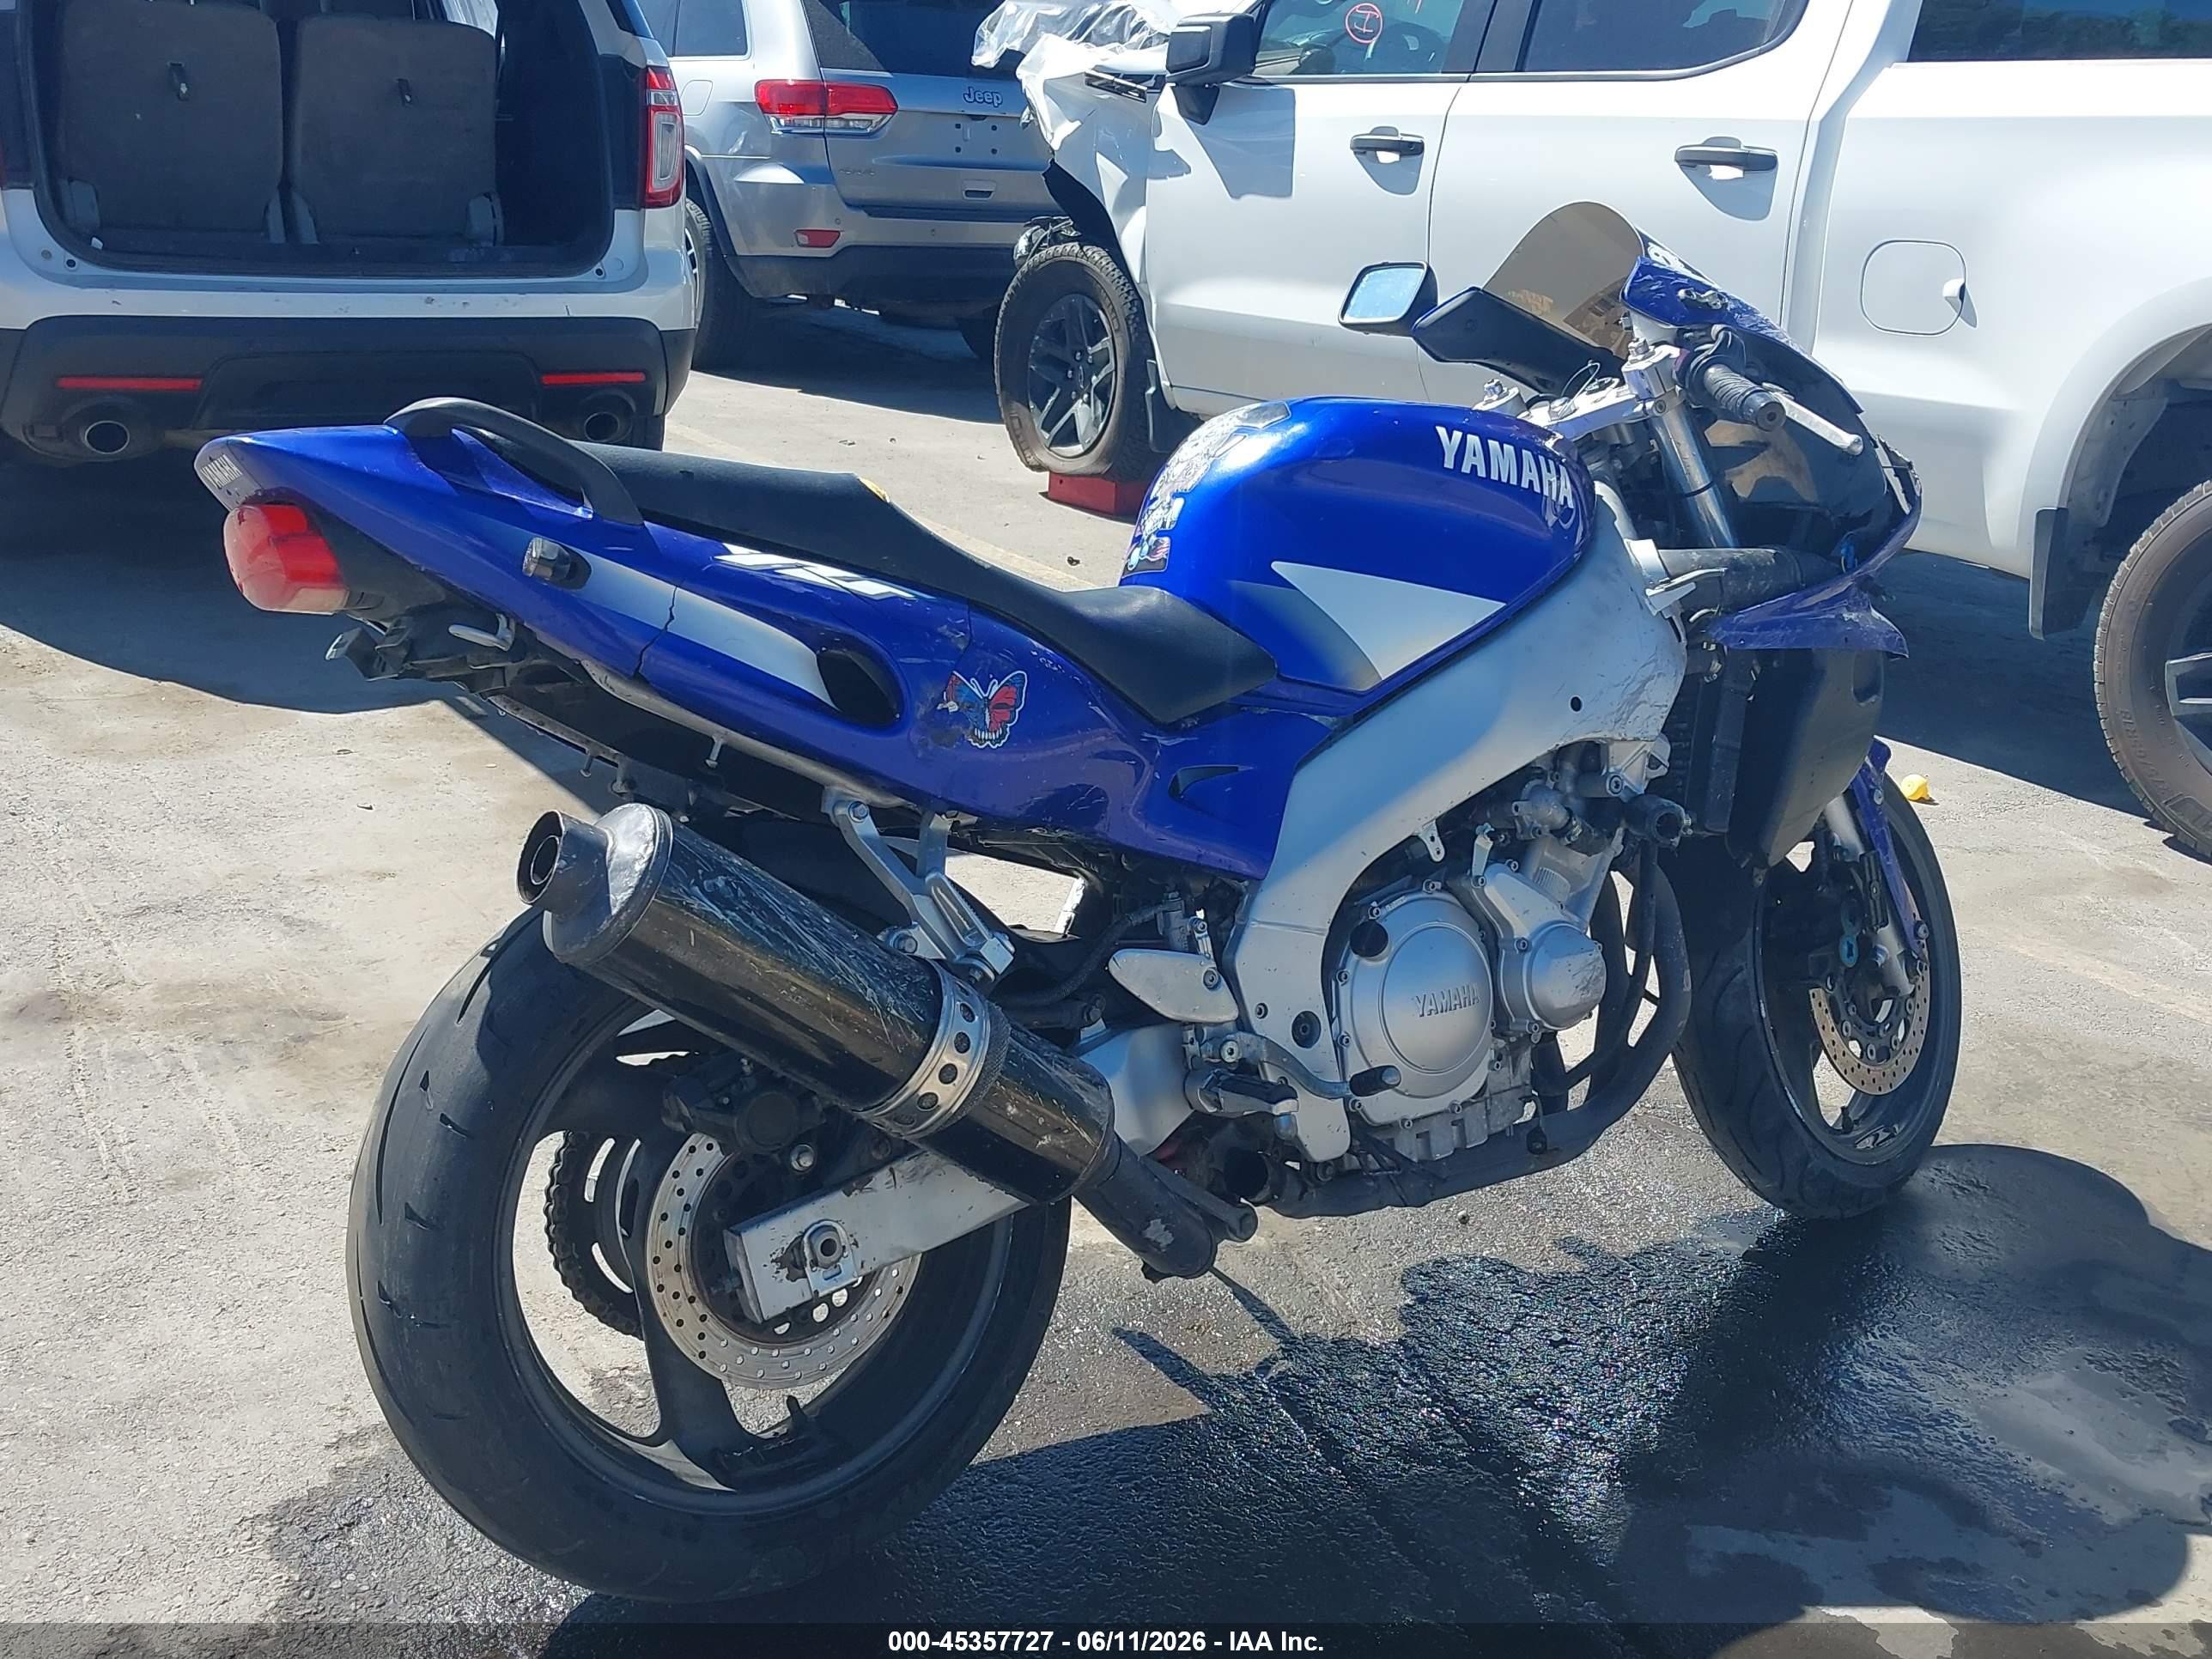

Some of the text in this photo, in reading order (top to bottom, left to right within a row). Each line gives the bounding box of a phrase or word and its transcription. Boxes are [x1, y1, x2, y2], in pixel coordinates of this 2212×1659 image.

[963, 86, 1003, 108] Jeep
[200, 453, 243, 489] YAMAHA
[1436, 425, 1575, 509] YAMAHA
[1415, 983, 1480, 1018] YAMAHA
